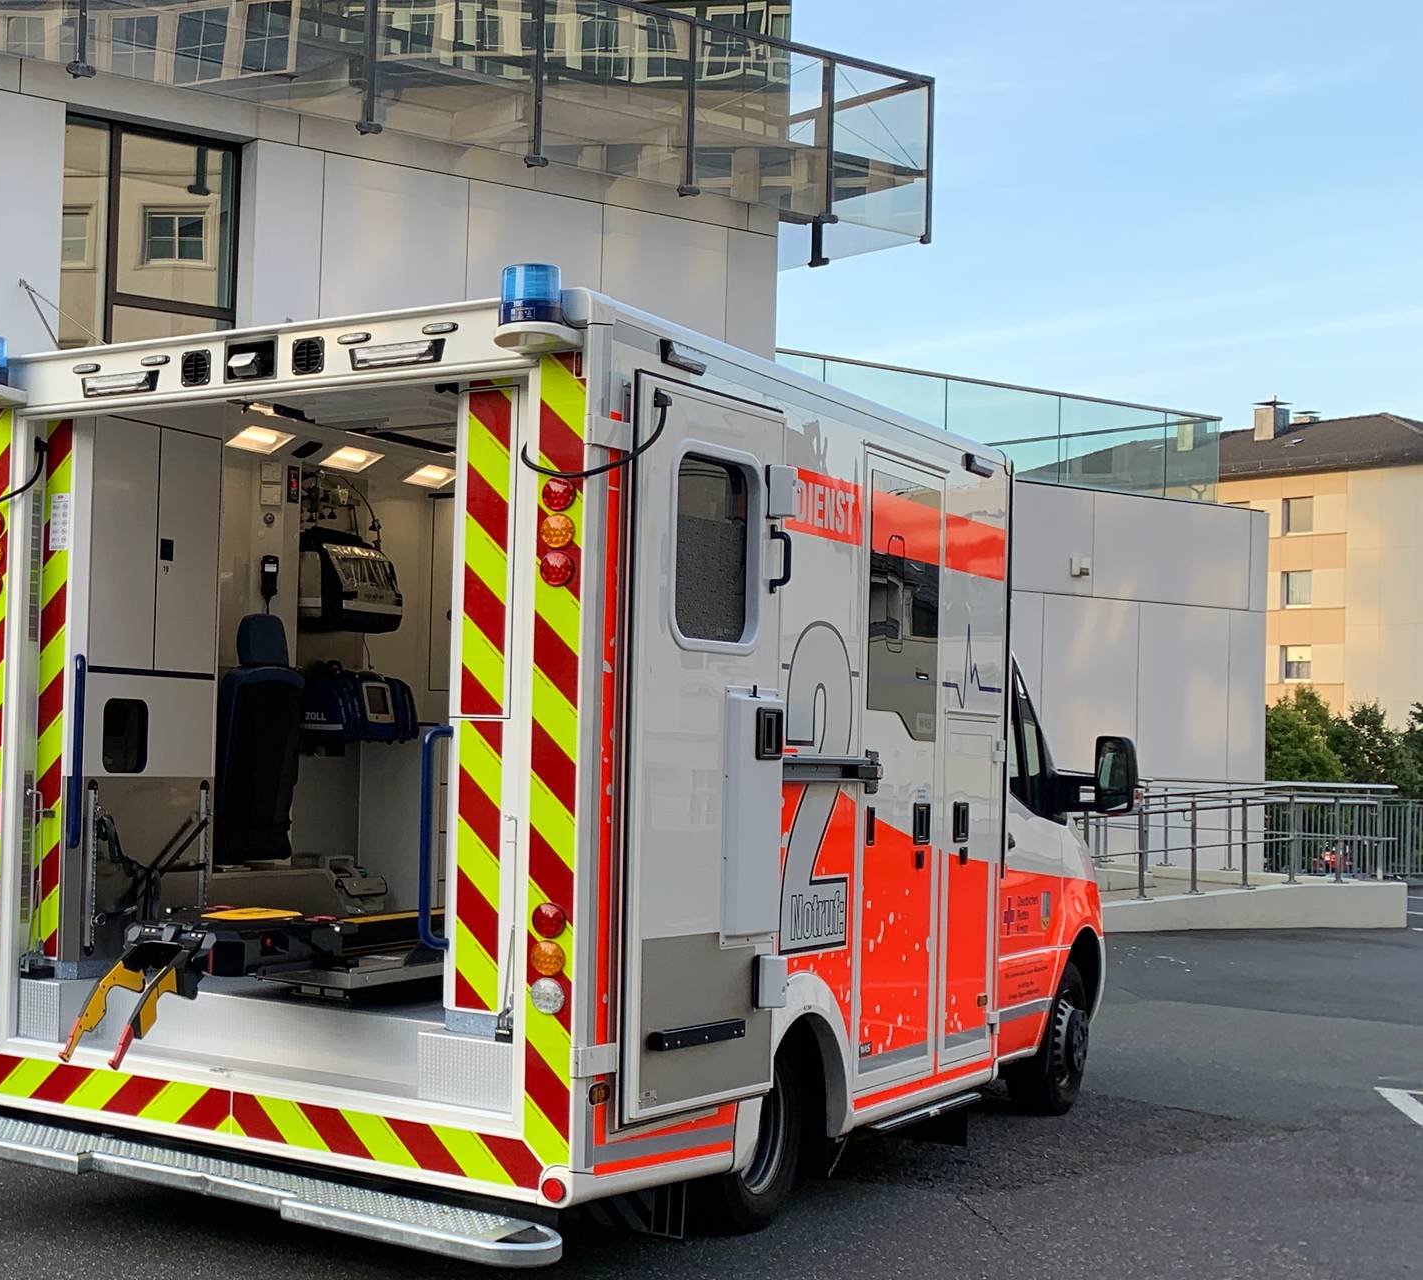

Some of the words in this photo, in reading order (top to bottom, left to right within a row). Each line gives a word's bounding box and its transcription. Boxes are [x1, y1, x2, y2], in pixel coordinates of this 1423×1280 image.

[795, 480, 856, 536] DIENST
[305, 711, 327, 721] ZOLL
[790, 889, 845, 941] Notruf:
